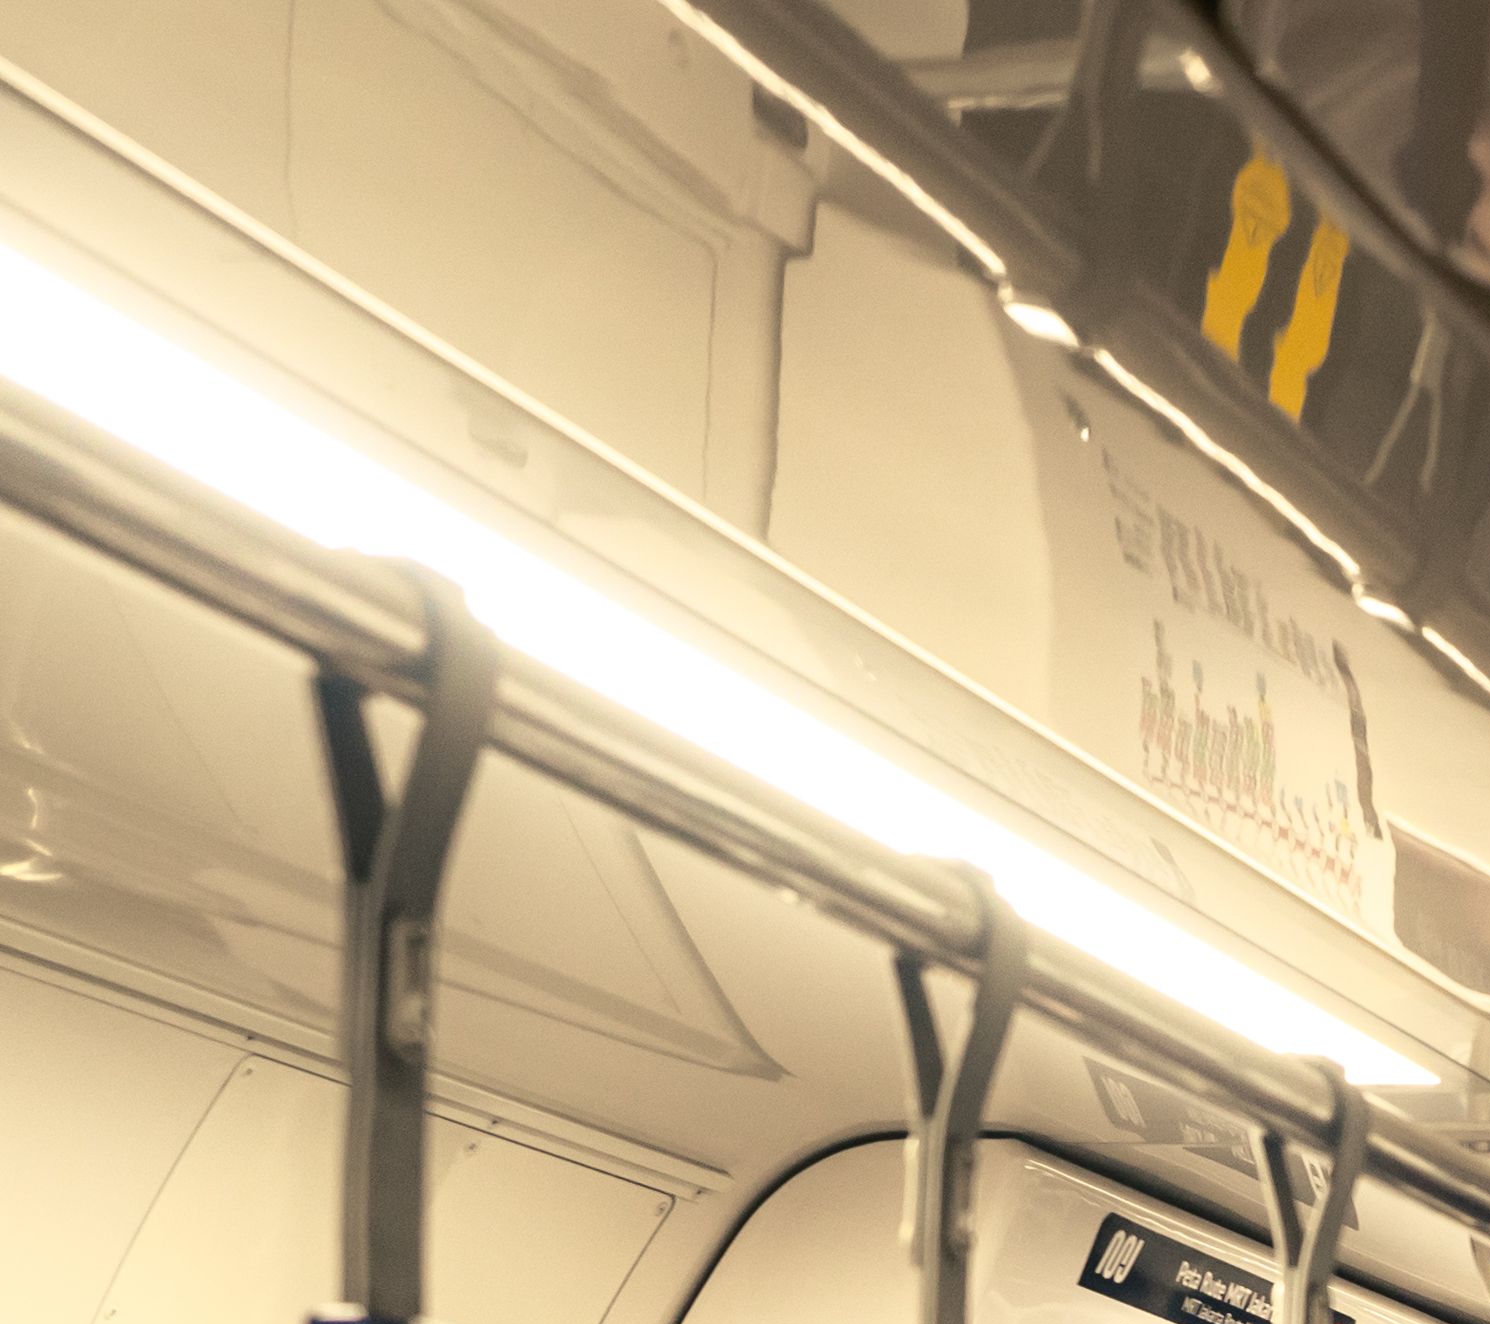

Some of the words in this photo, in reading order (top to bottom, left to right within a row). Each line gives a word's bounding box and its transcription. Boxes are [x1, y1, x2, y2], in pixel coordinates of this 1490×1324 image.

[1176, 1260, 1202, 1290] Peta
[1224, 1282, 1252, 1310] MRT
[1246, 1292, 1273, 1321] Jaka
